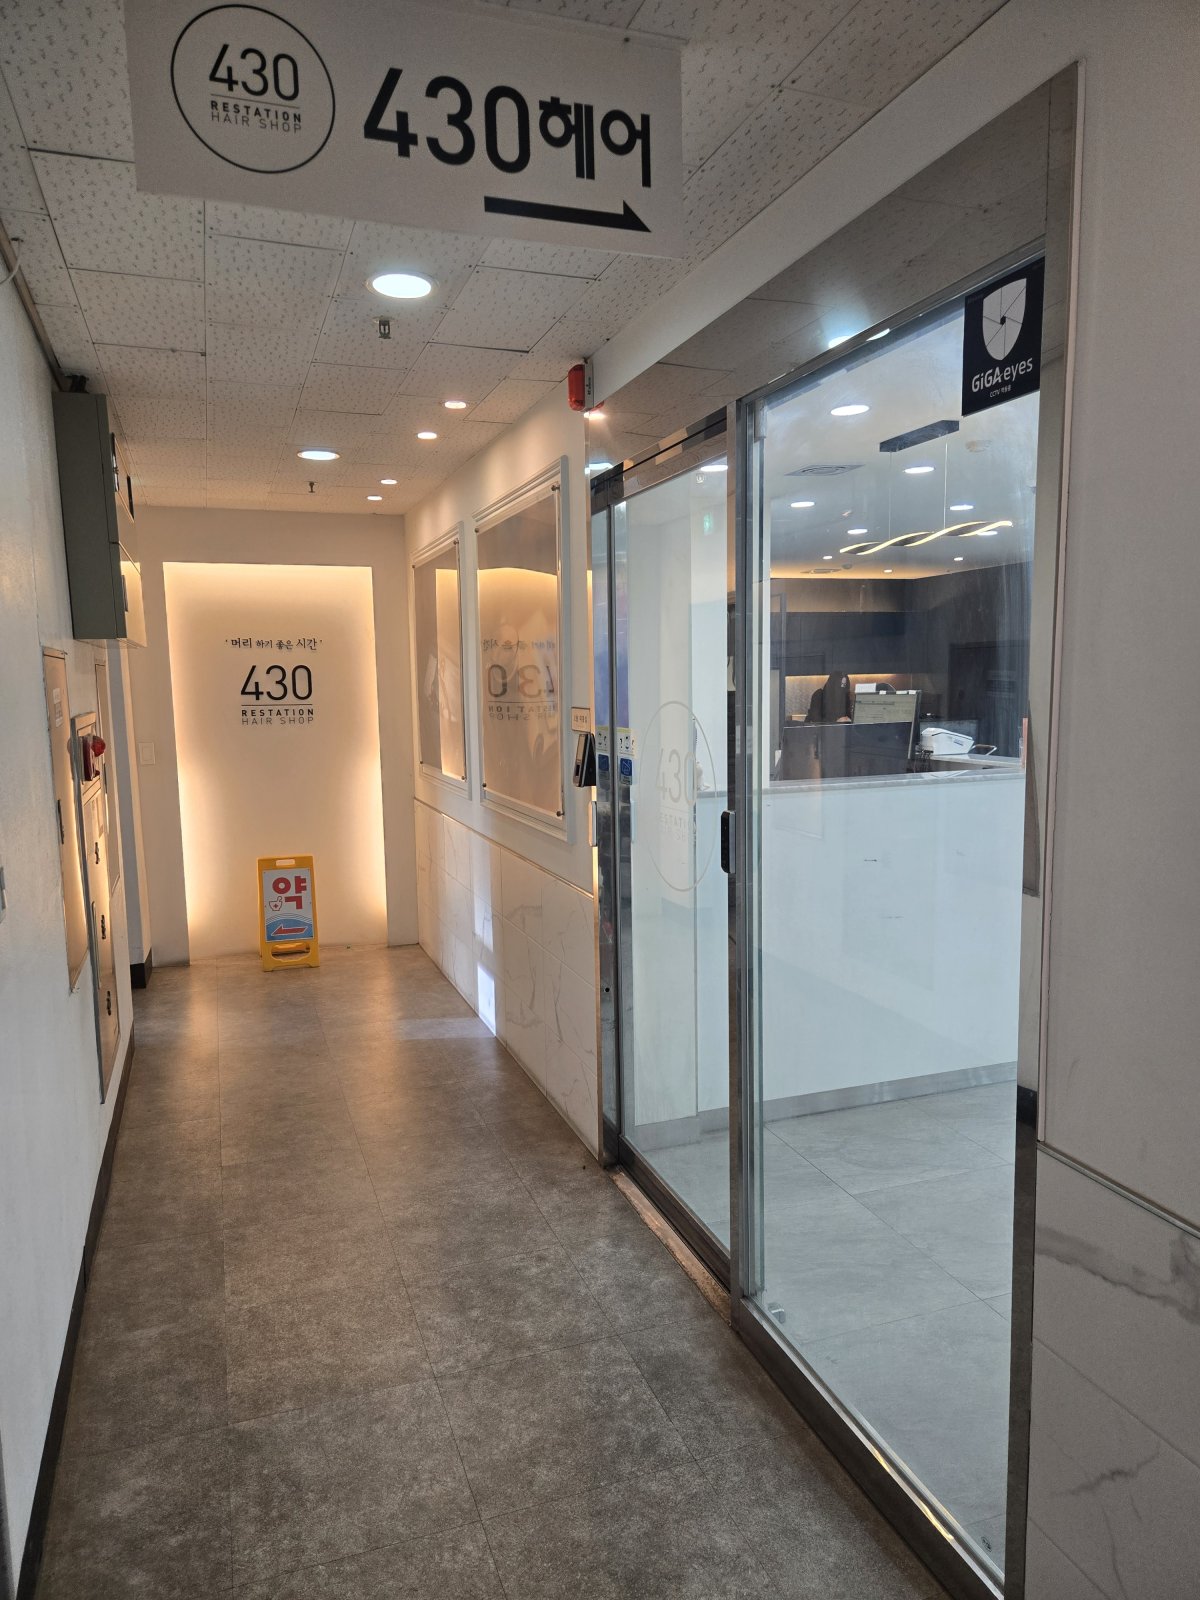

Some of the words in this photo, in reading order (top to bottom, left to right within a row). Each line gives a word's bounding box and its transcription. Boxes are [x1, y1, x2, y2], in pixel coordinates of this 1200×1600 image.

[208, 43, 300, 102] 430
[210, 100, 302, 123] RESTATION
[211, 111, 250, 127] HAIR
[259, 118, 302, 133] SHOP
[363, 66, 652, 188] 430헤어
[256, 640, 273, 649] 하기
[276, 640, 293, 650] 좋은
[240, 664, 313, 701] 430
[241, 708, 314, 717] RESTATION
[241, 716, 273, 726] HAIR
[279, 716, 314, 725] SHOP
[655, 748, 697, 807] 430
[272, 875, 307, 910] 약
